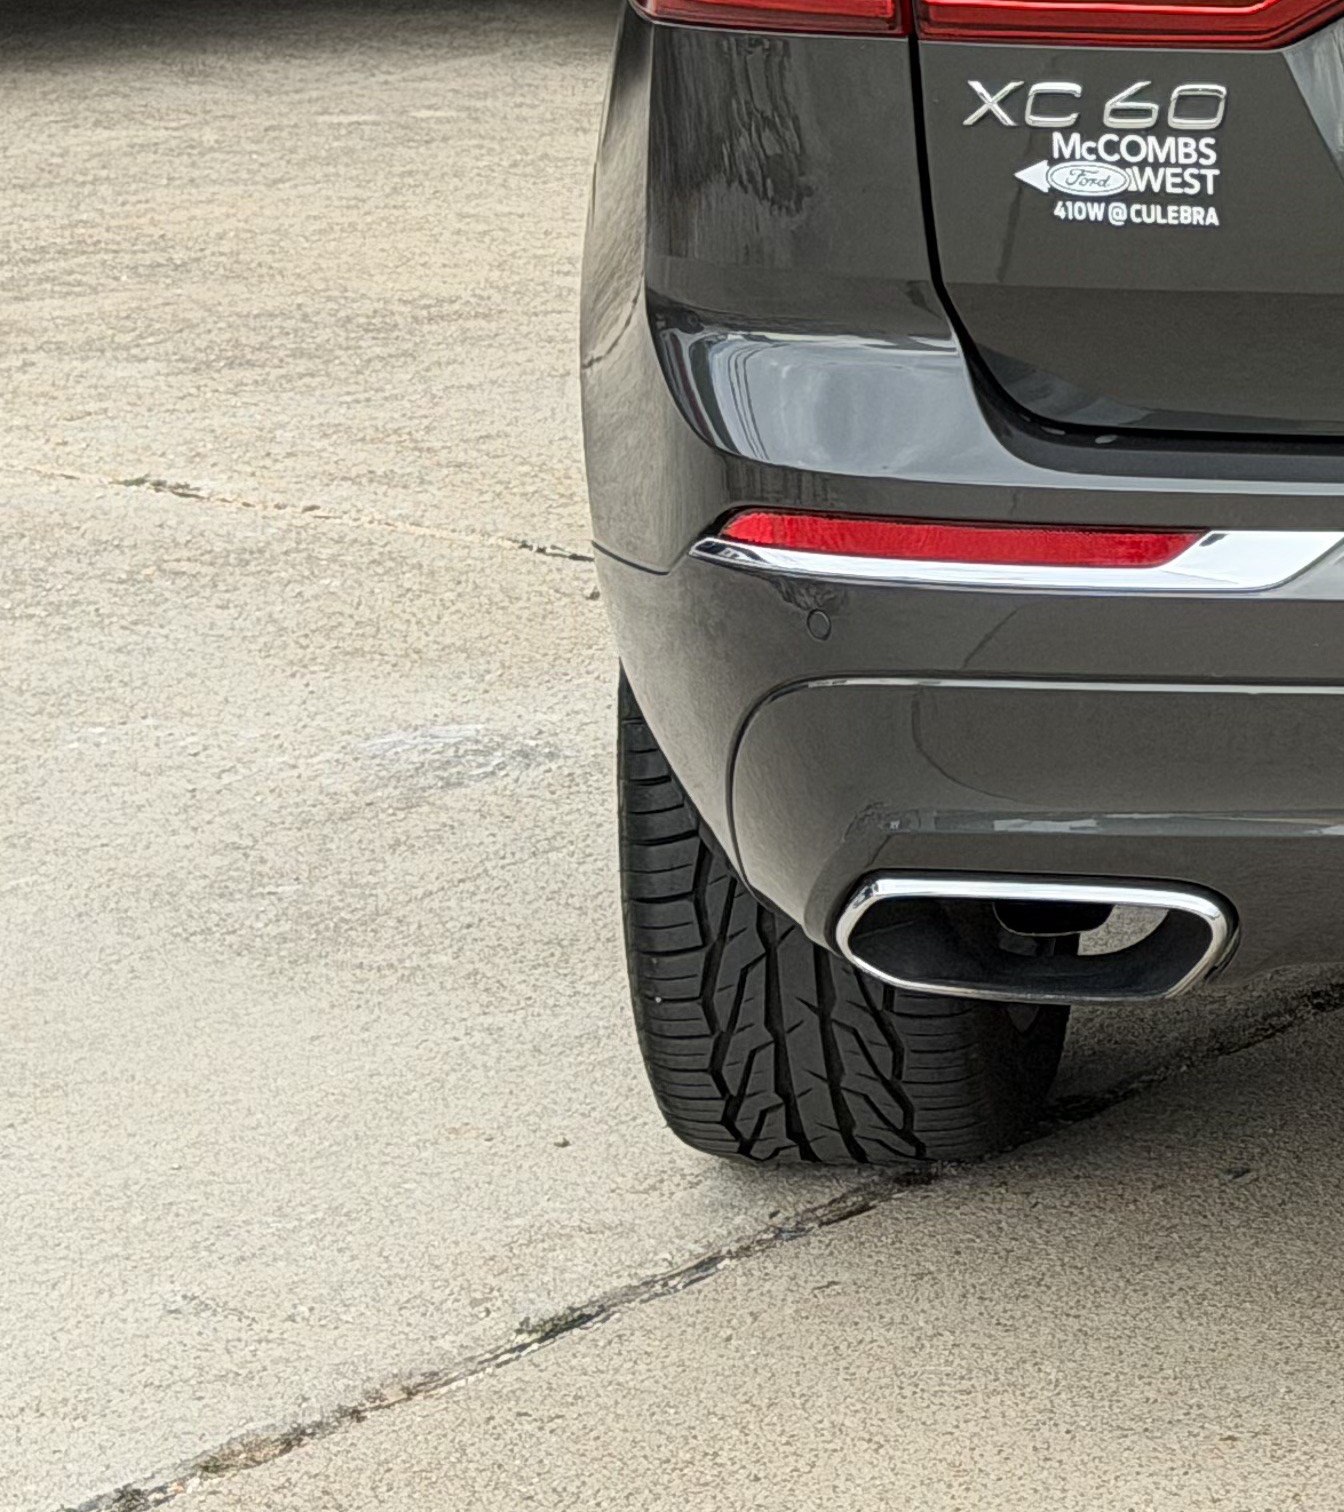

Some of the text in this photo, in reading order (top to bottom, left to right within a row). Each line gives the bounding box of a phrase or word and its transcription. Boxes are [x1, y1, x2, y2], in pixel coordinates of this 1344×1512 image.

[1052, 131, 1217, 165] McCOMBS
[1064, 166, 1220, 195] Ford WEST
